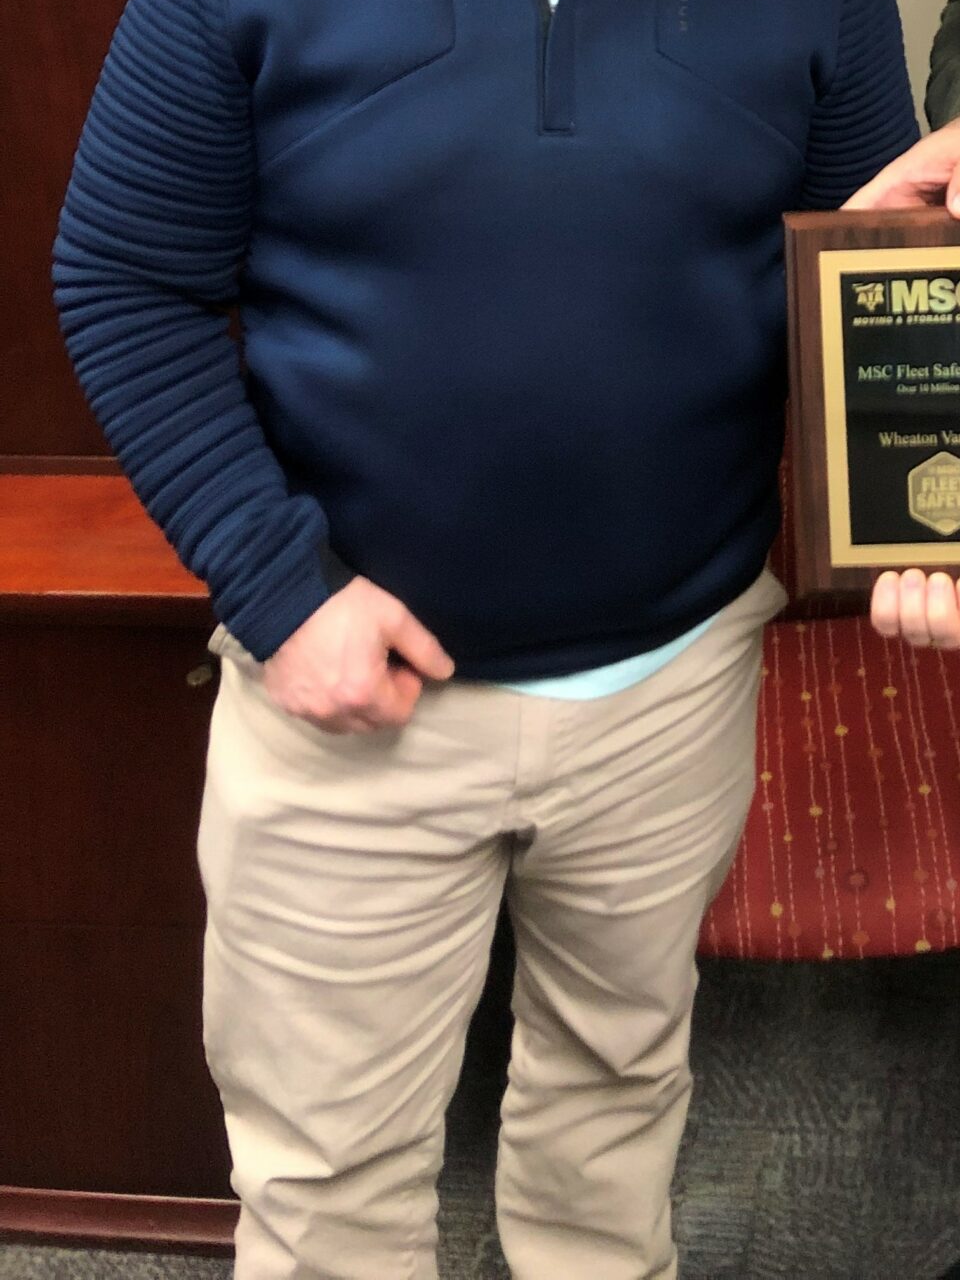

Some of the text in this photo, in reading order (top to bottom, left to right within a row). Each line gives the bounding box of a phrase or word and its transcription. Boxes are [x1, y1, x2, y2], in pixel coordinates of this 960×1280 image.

[852, 316, 893, 325] MOVING
[907, 314, 952, 324] STORAGE
[858, 365, 892, 380] MSC
[896, 364, 929, 378] Fleet
[896, 383, 917, 393] Over
[879, 431, 938, 446] Wheaton
